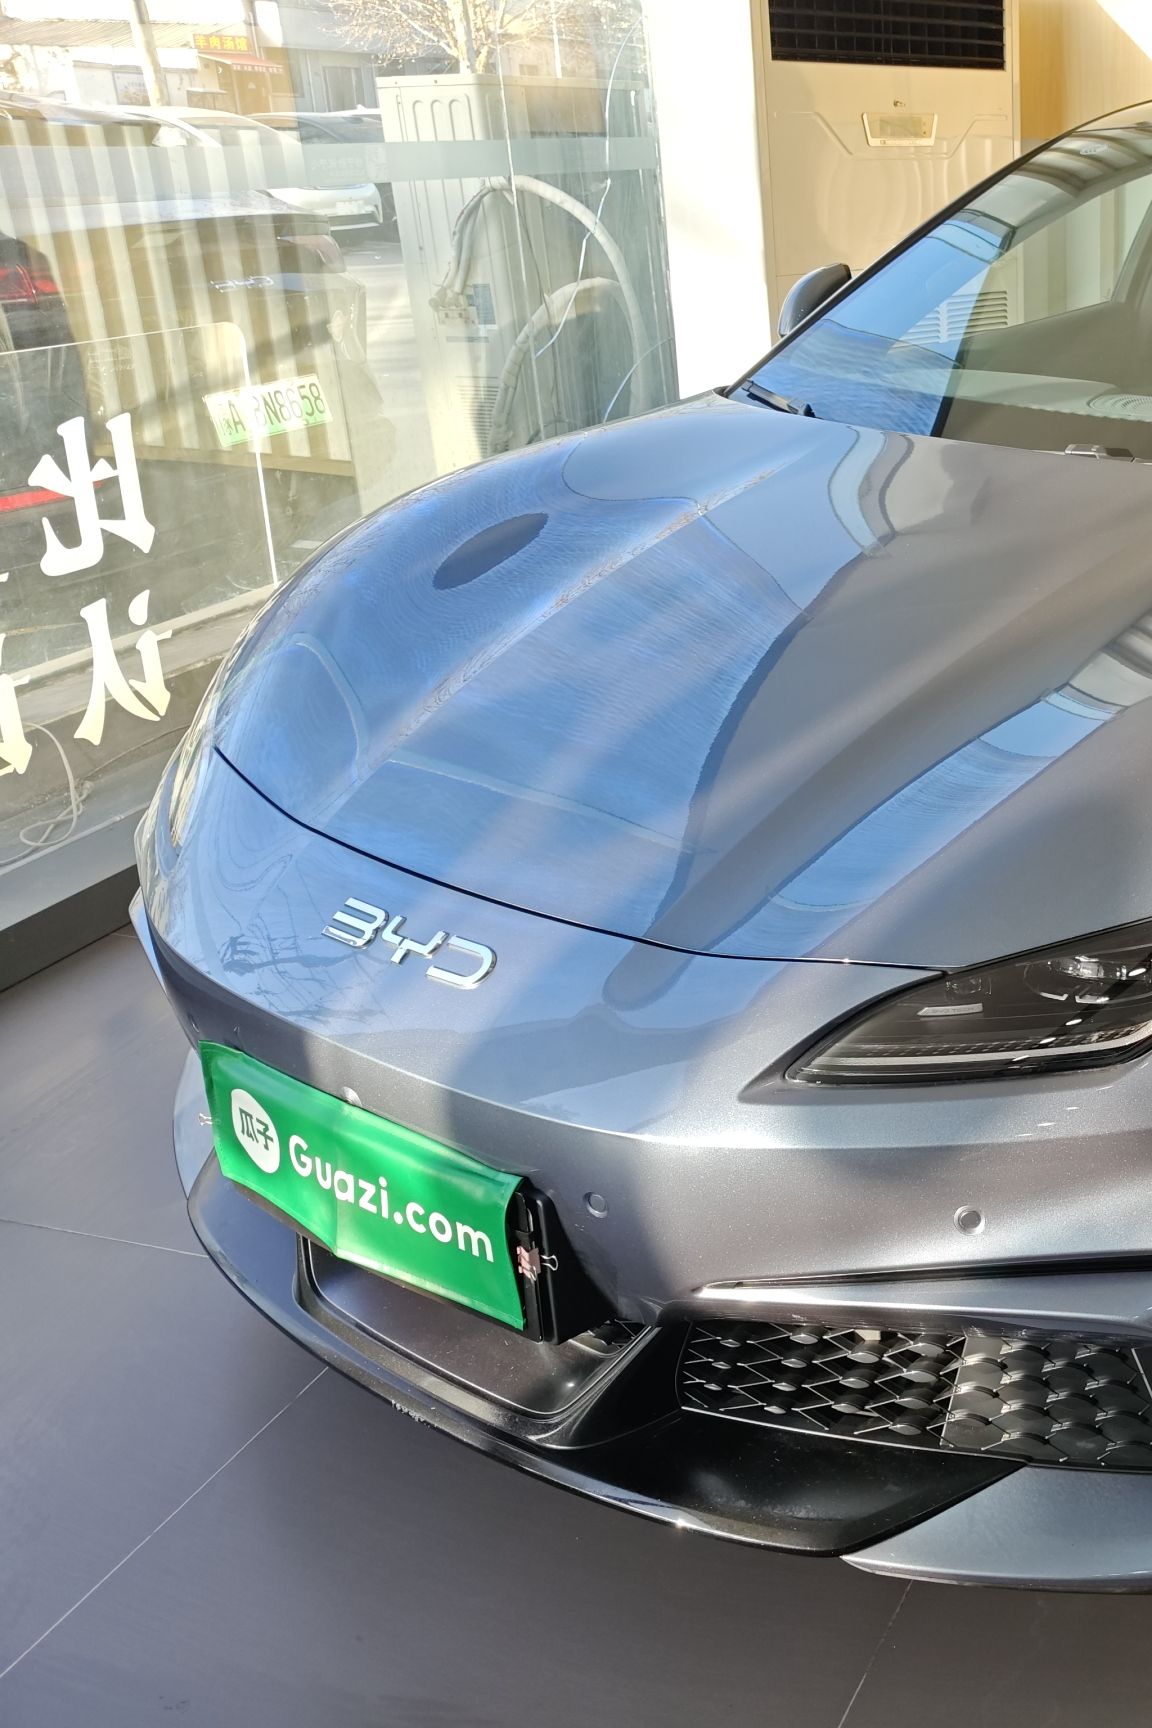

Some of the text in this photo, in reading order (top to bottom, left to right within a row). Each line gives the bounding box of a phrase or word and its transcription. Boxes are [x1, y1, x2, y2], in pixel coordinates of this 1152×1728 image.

[322, 897, 497, 989] BYD
[238, 1106, 274, 1152] 瓜子
[289, 1134, 495, 1263] Guazi.com
